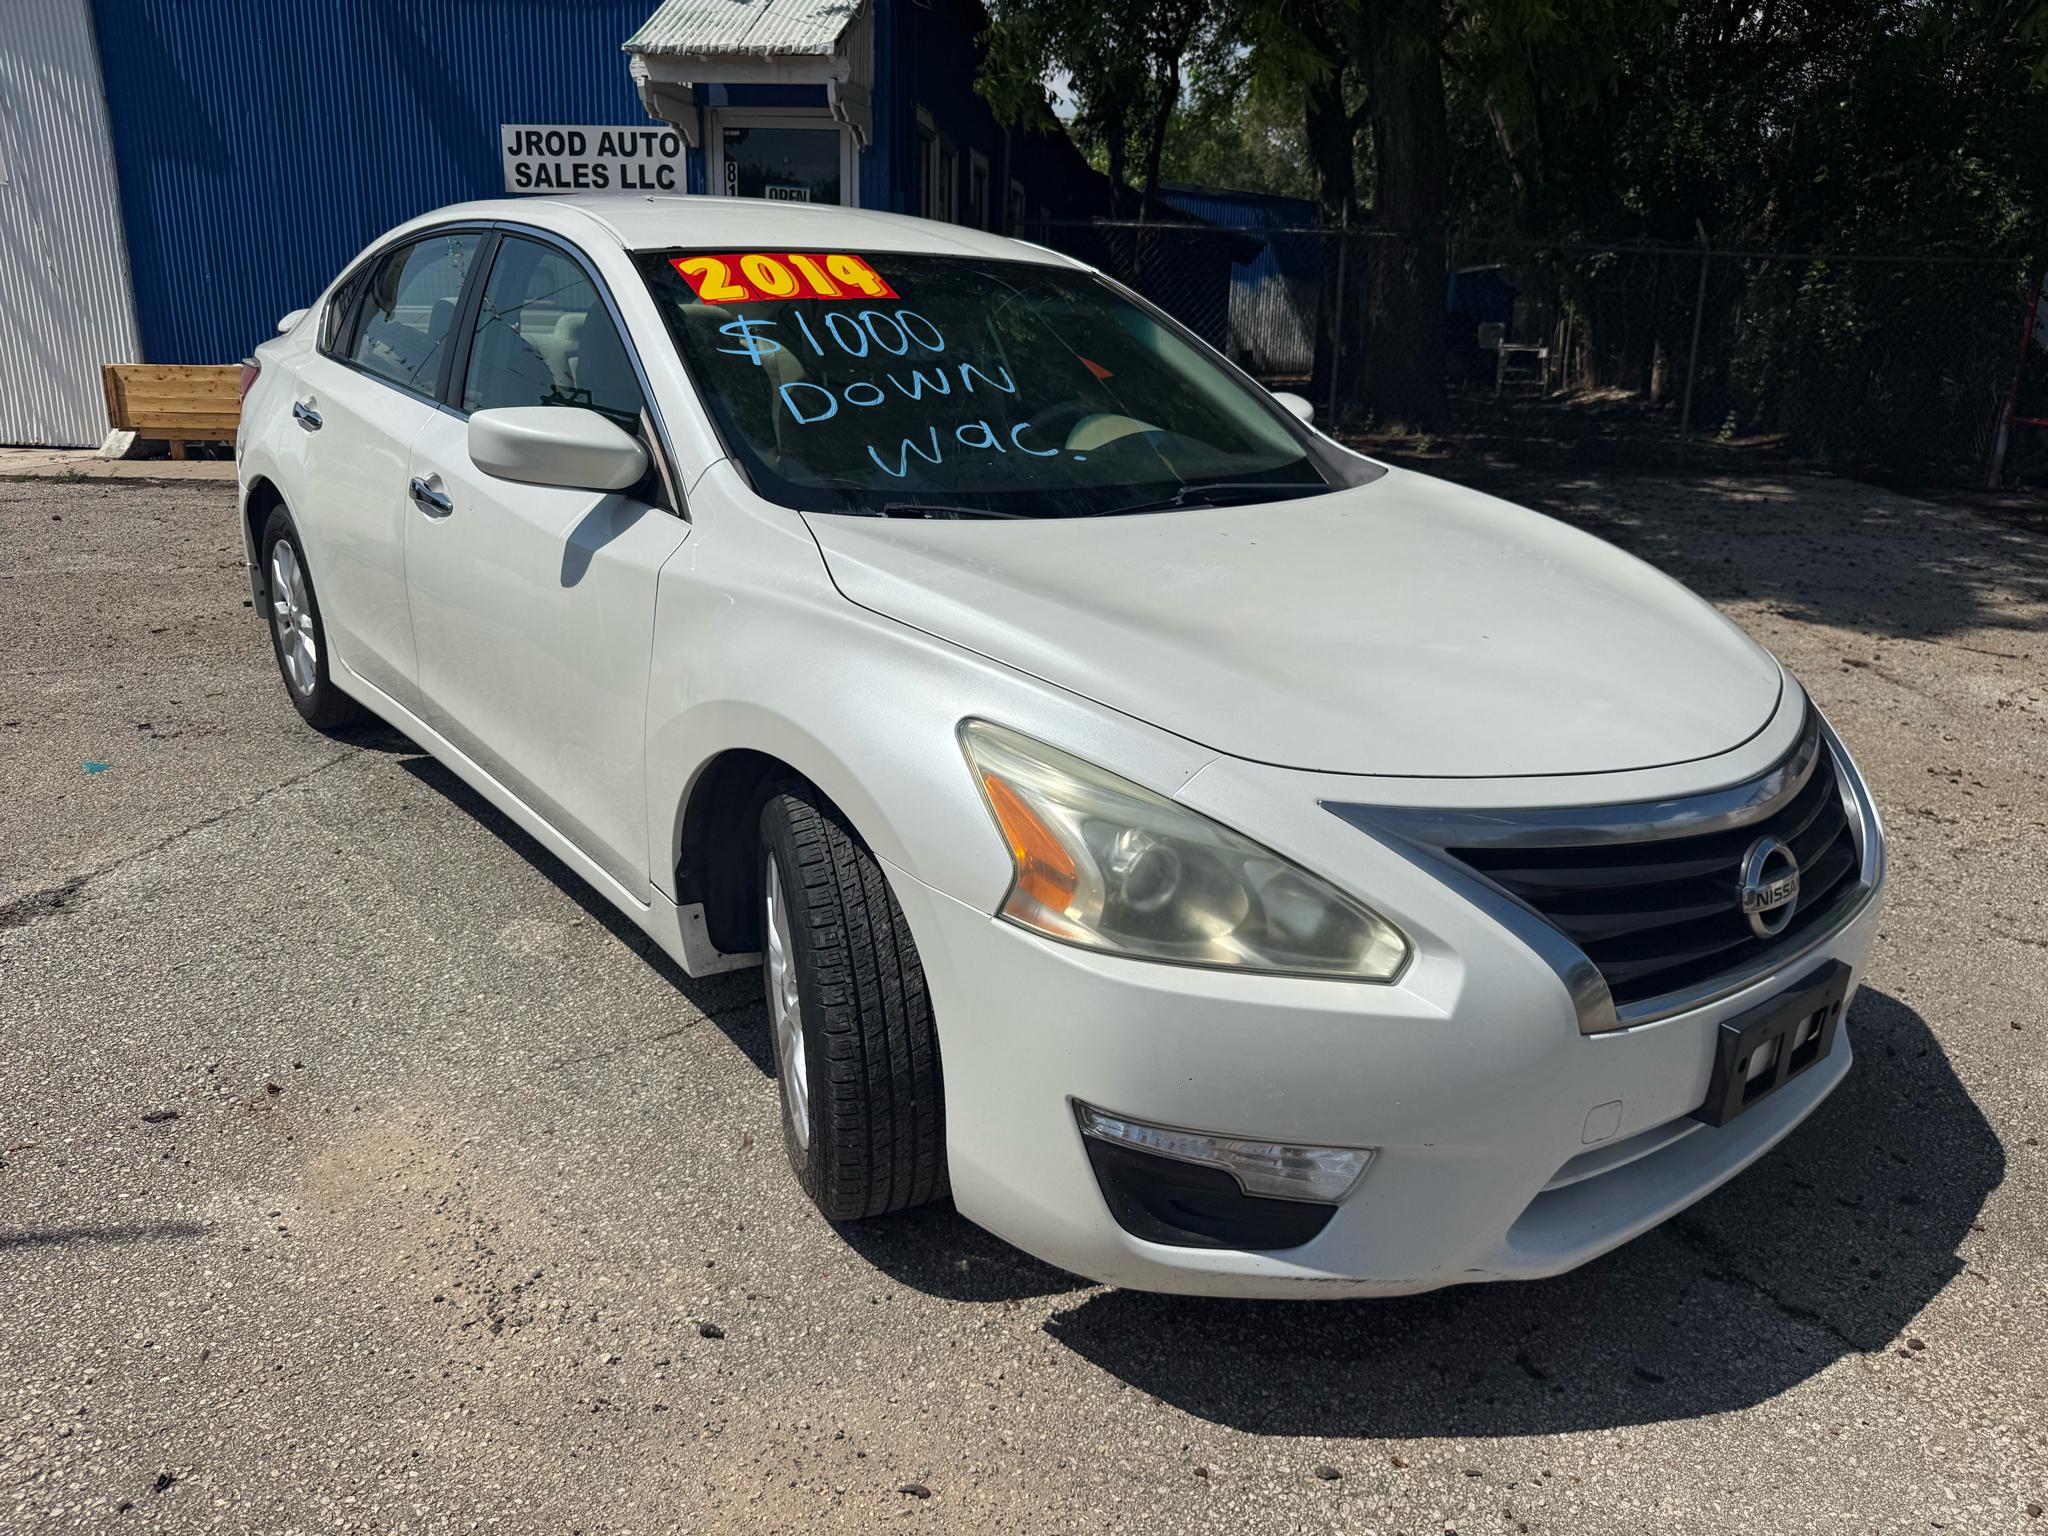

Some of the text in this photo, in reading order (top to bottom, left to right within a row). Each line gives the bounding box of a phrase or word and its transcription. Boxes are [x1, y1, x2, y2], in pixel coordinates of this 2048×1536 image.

[507, 130, 681, 158] JROD AUTO
[515, 162, 676, 190] SALES LLC
[679, 255, 888, 301] 2014
[716, 310, 944, 366] $1000
[1757, 879, 1798, 907] NISSA
